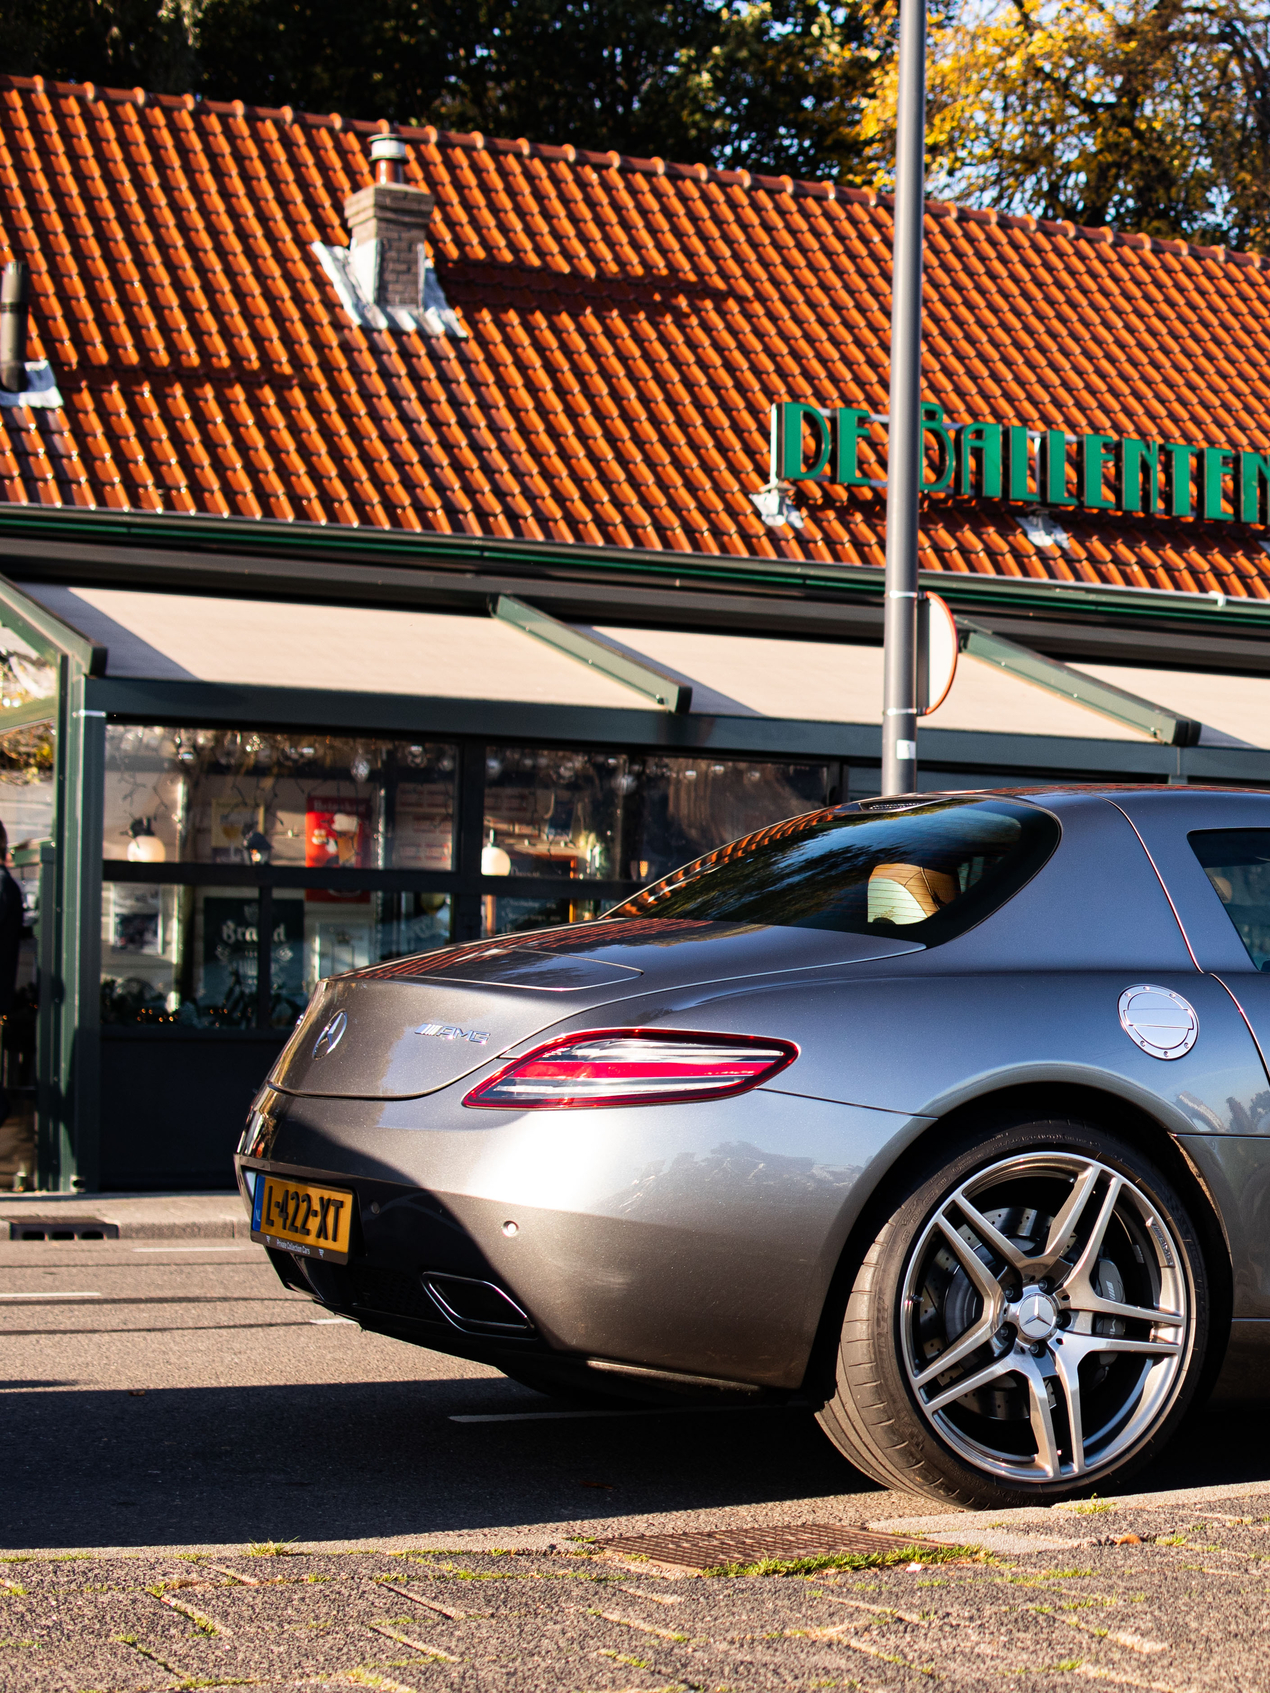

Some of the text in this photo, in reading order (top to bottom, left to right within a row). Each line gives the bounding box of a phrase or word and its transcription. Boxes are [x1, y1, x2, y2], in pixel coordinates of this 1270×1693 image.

[783, 402, 871, 486] DE
[221, 919, 287, 943] Brad
[436, 1025, 491, 1045] AMG
[264, 1185, 344, 1242] L-422-XT
